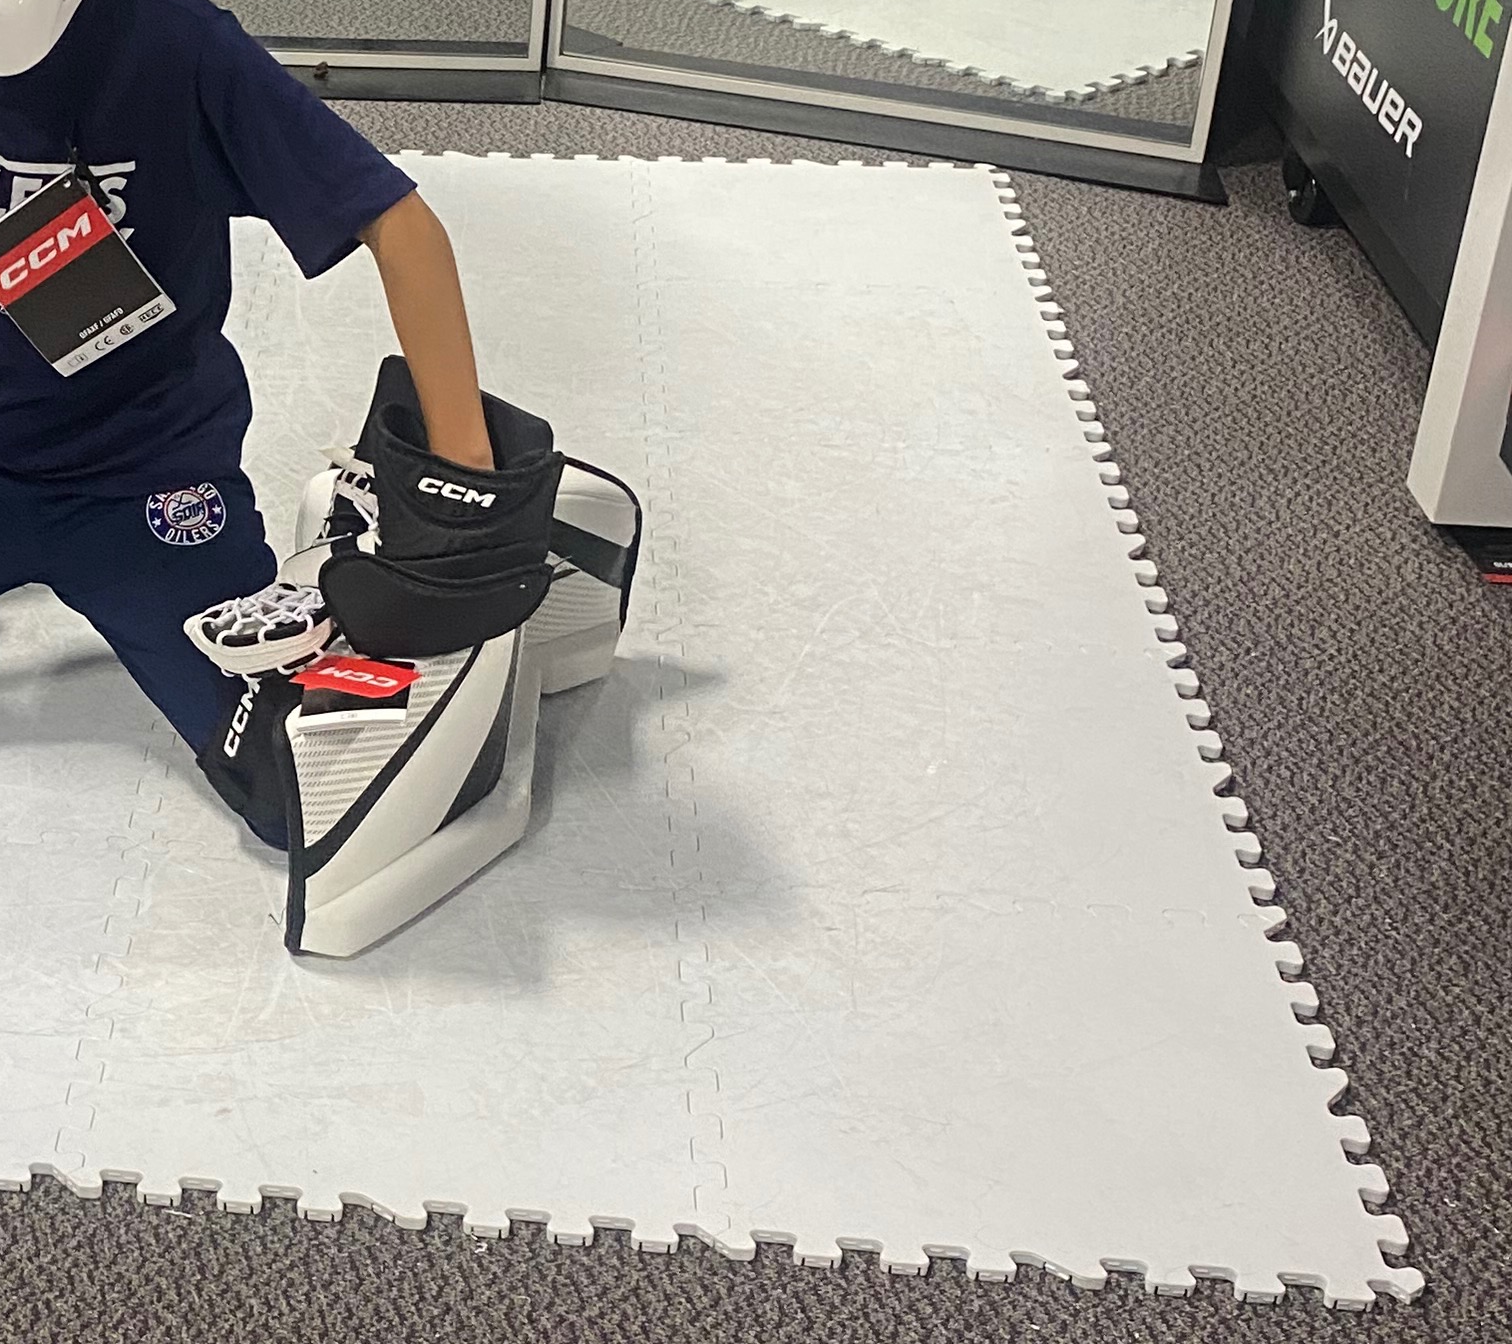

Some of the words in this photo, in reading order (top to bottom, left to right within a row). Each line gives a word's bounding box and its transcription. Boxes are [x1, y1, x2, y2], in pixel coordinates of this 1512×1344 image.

[1331, 30, 1424, 159] BAUER
[0, 211, 93, 291] CCM
[416, 476, 497, 509] CCM
[164, 520, 221, 544] OILERS
[316, 666, 400, 689] CCM
[223, 677, 261, 758] CCM
